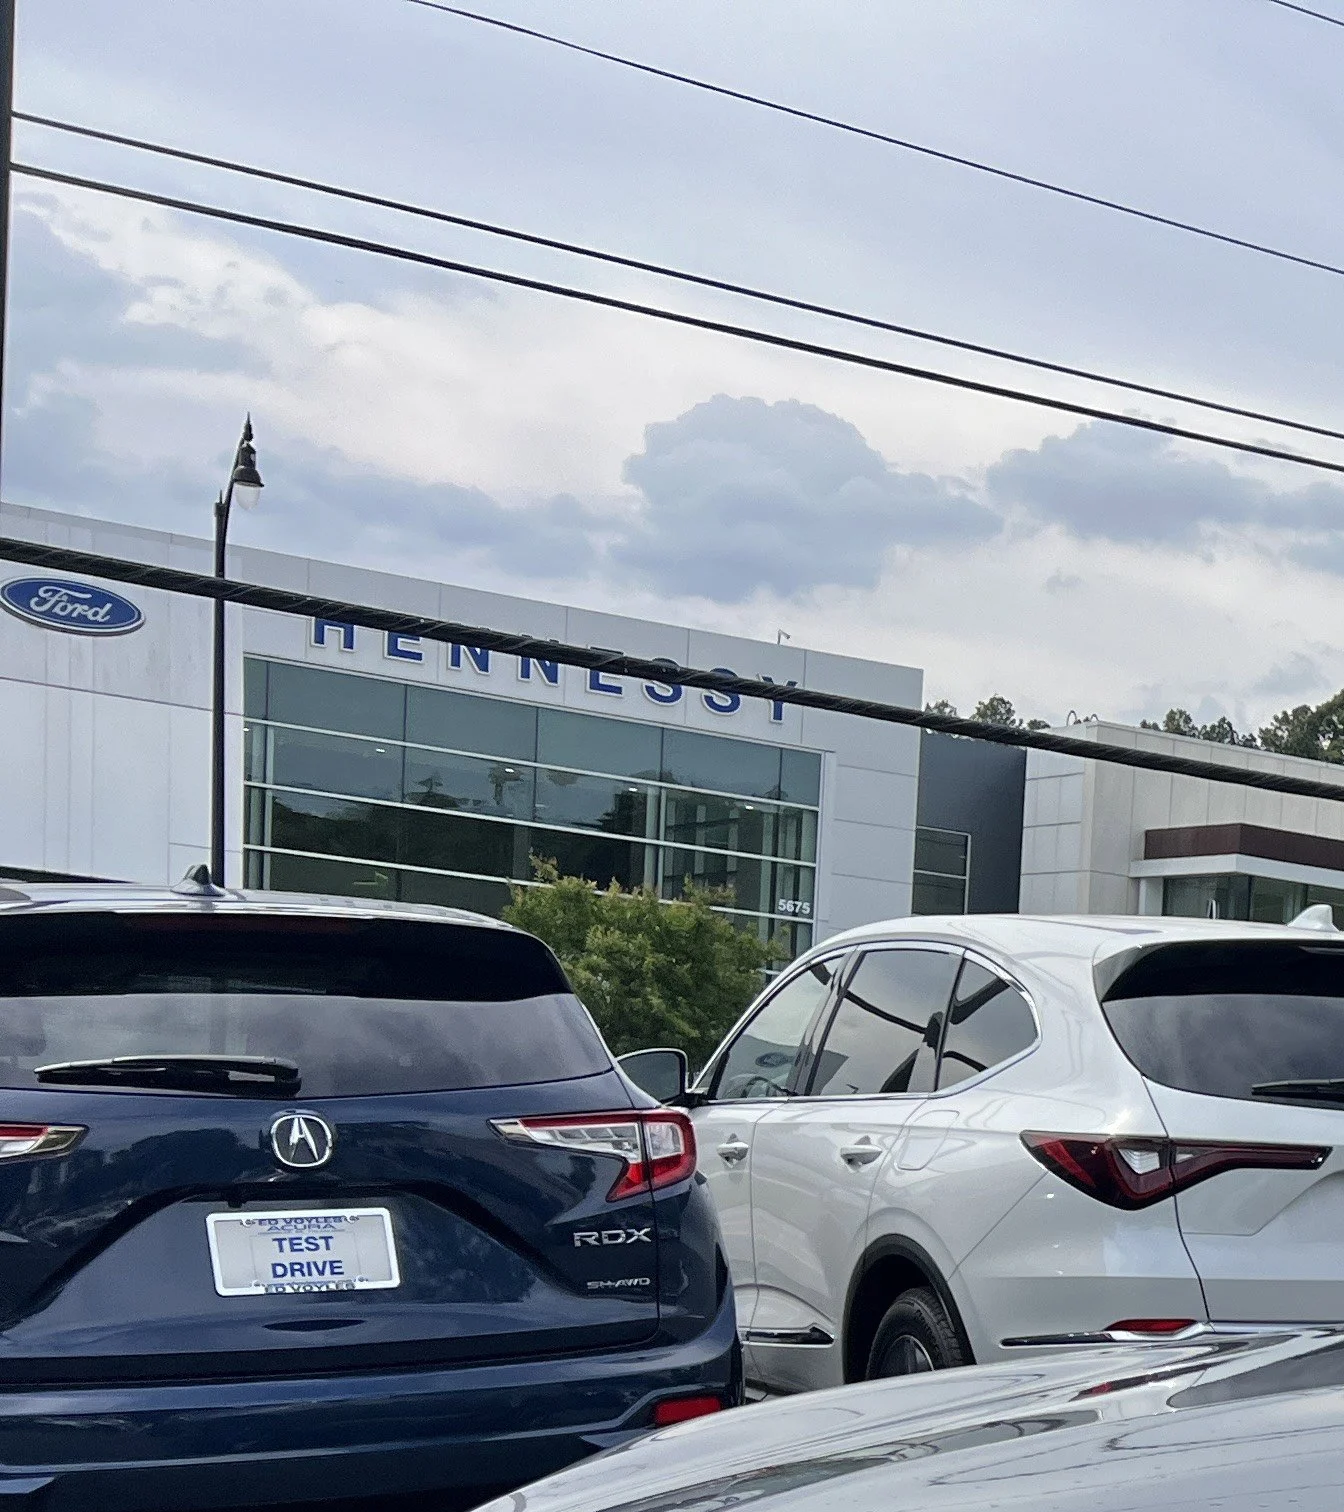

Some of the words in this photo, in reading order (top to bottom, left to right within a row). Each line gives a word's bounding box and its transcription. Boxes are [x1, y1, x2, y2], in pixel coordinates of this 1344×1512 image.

[30, 585, 113, 623] Ford
[312, 612, 799, 722] HENNESSY
[778, 899, 811, 914] 5675
[271, 1235, 335, 1253] TEST
[573, 1227, 652, 1247] RDX
[270, 1260, 345, 1279] DRIVE
